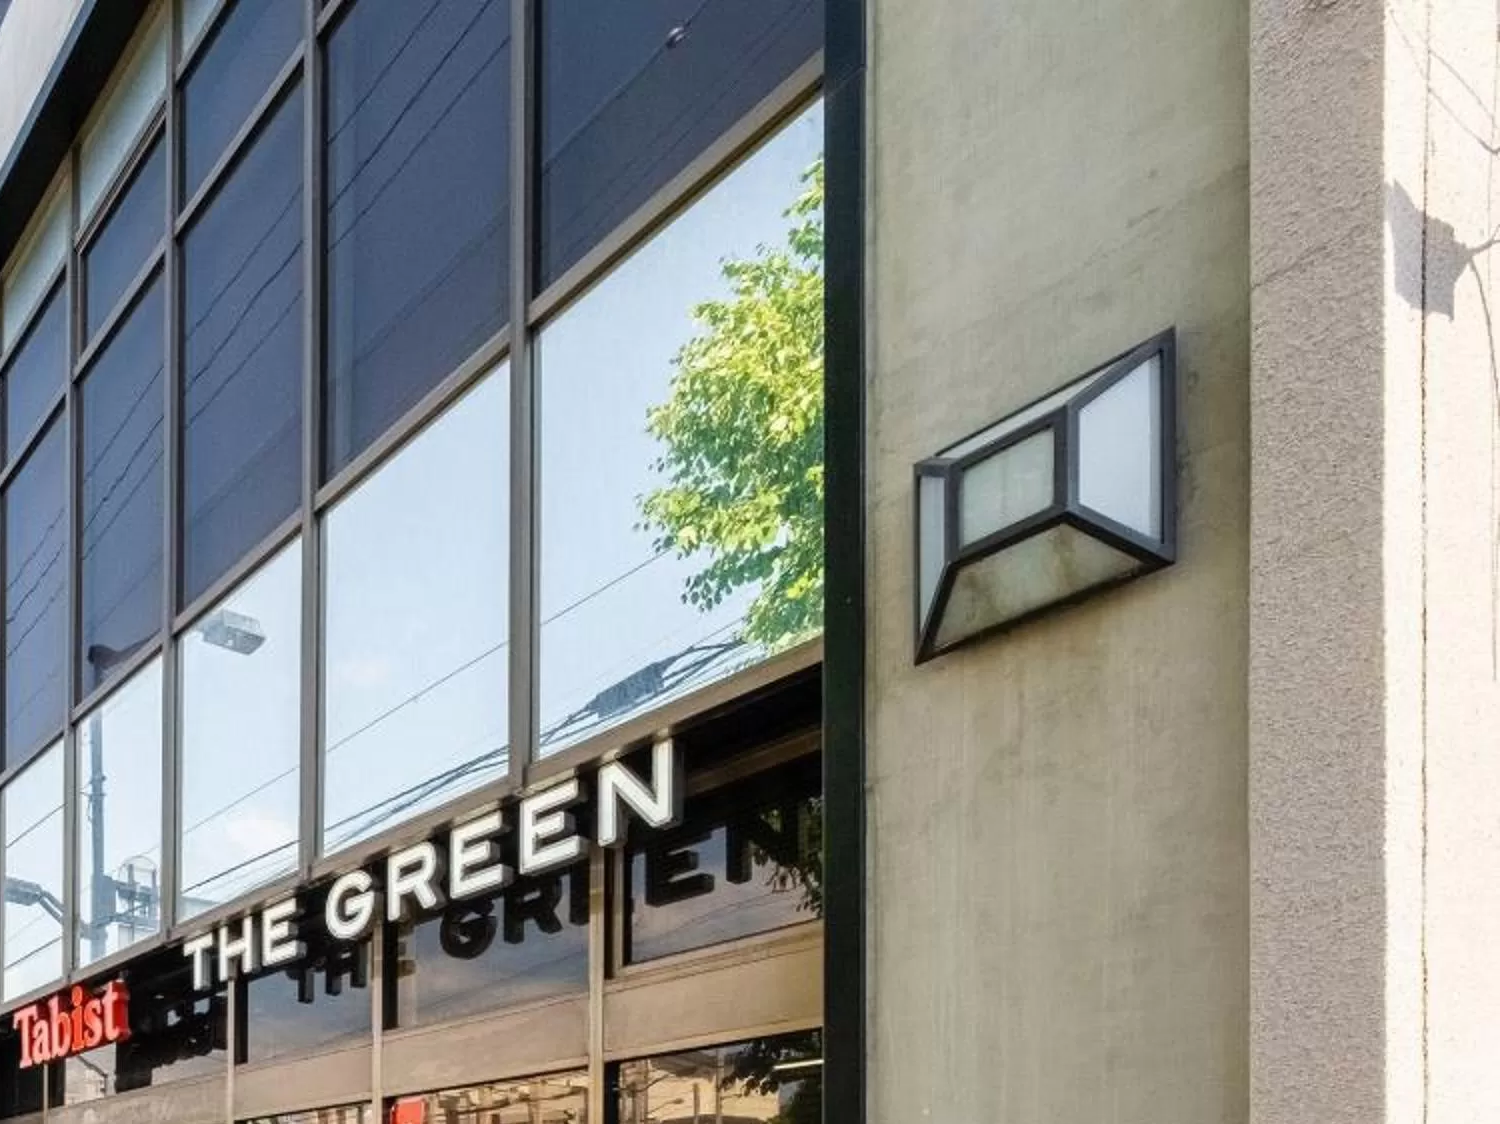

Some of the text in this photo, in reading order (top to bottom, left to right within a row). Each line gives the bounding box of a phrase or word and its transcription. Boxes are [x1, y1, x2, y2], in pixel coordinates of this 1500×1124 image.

[12, 979, 131, 1070] Tabist
[182, 898, 301, 992] THE
[324, 738, 679, 940] GREEN
